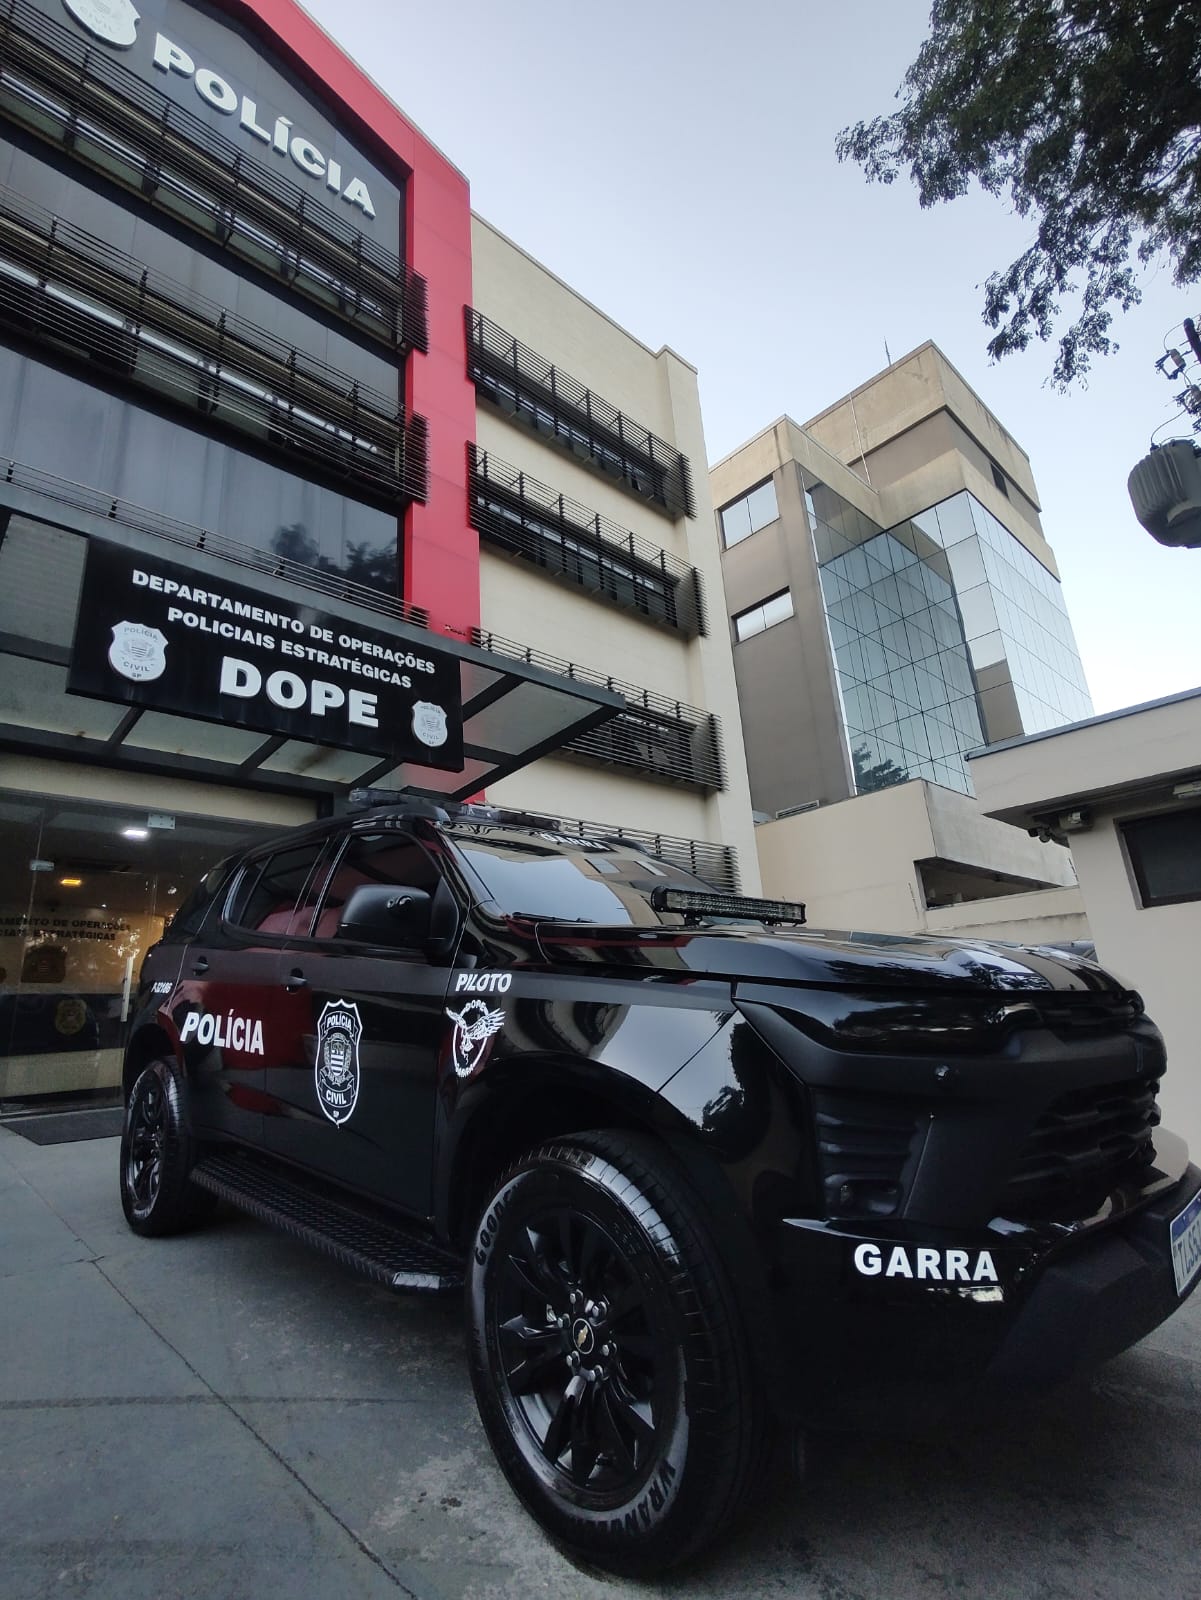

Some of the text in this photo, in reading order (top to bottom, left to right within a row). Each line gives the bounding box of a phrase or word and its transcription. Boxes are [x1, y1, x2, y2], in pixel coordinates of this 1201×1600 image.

[153, 32, 376, 220] POLÍCIA
[132, 569, 436, 674] DEPARTAMENTO DE OPERAÇÕES
[123, 661, 151, 672] CIVIL
[167, 606, 412, 689] POLICIAIS ESTRATÉGICAS
[219, 656, 379, 728] DOPE
[455, 973, 512, 992] PILOTO
[180, 1008, 264, 1056] POLÍCIA
[325, 1089, 347, 1105] CIVIL
[854, 1243, 999, 1282] GARRA
